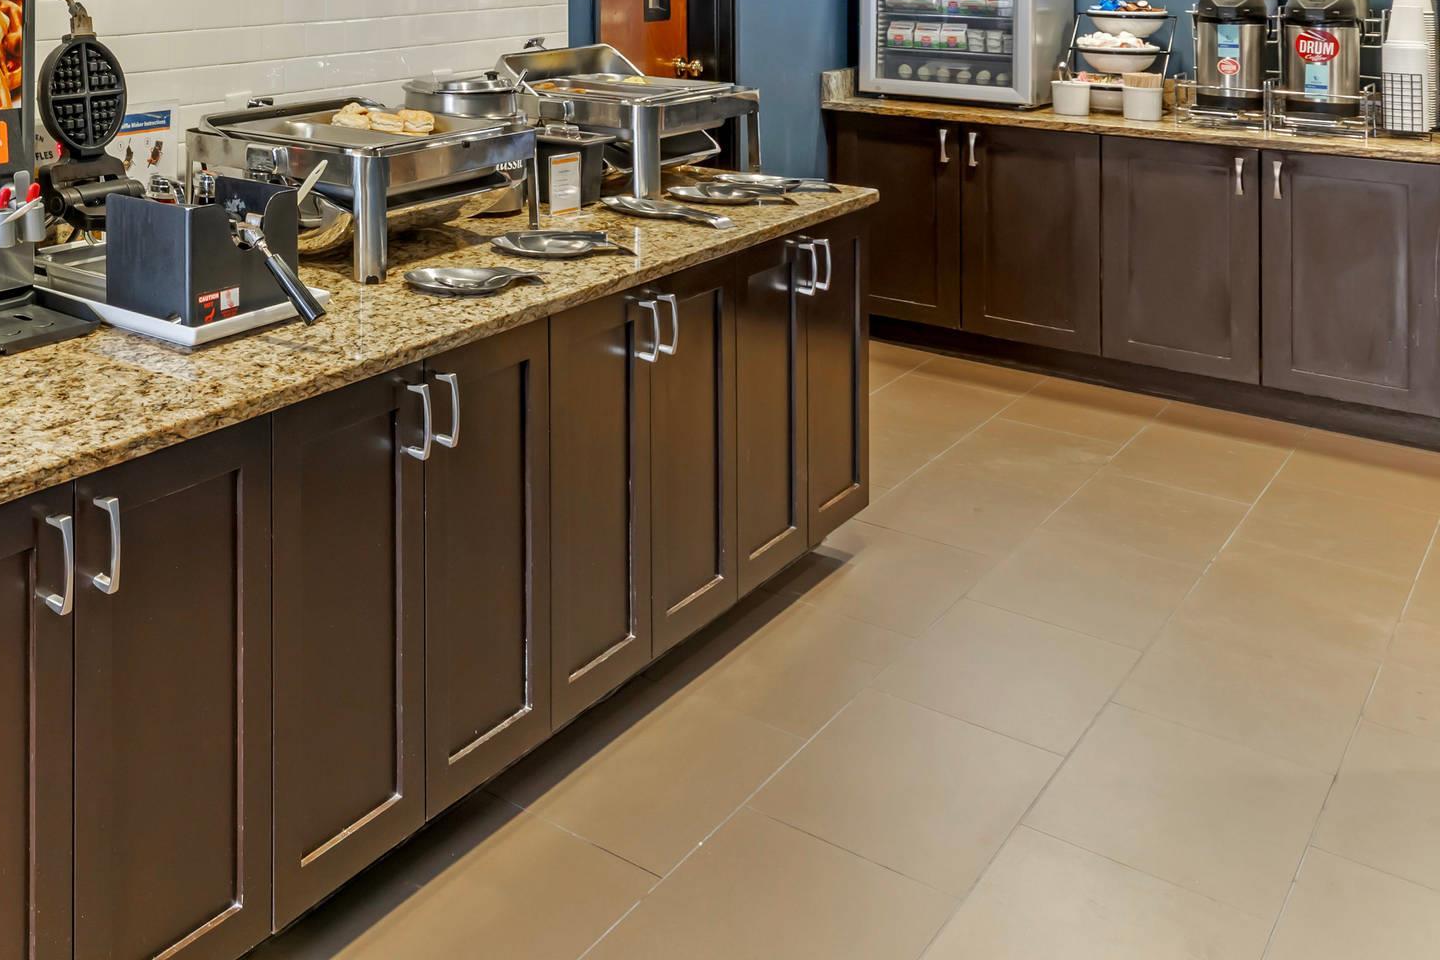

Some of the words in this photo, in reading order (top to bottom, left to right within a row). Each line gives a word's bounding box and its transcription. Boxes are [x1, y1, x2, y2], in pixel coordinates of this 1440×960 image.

[1299, 39, 1335, 56] DRUM
[35, 150, 54, 161] FLES
[198, 292, 219, 303] CAUTION
